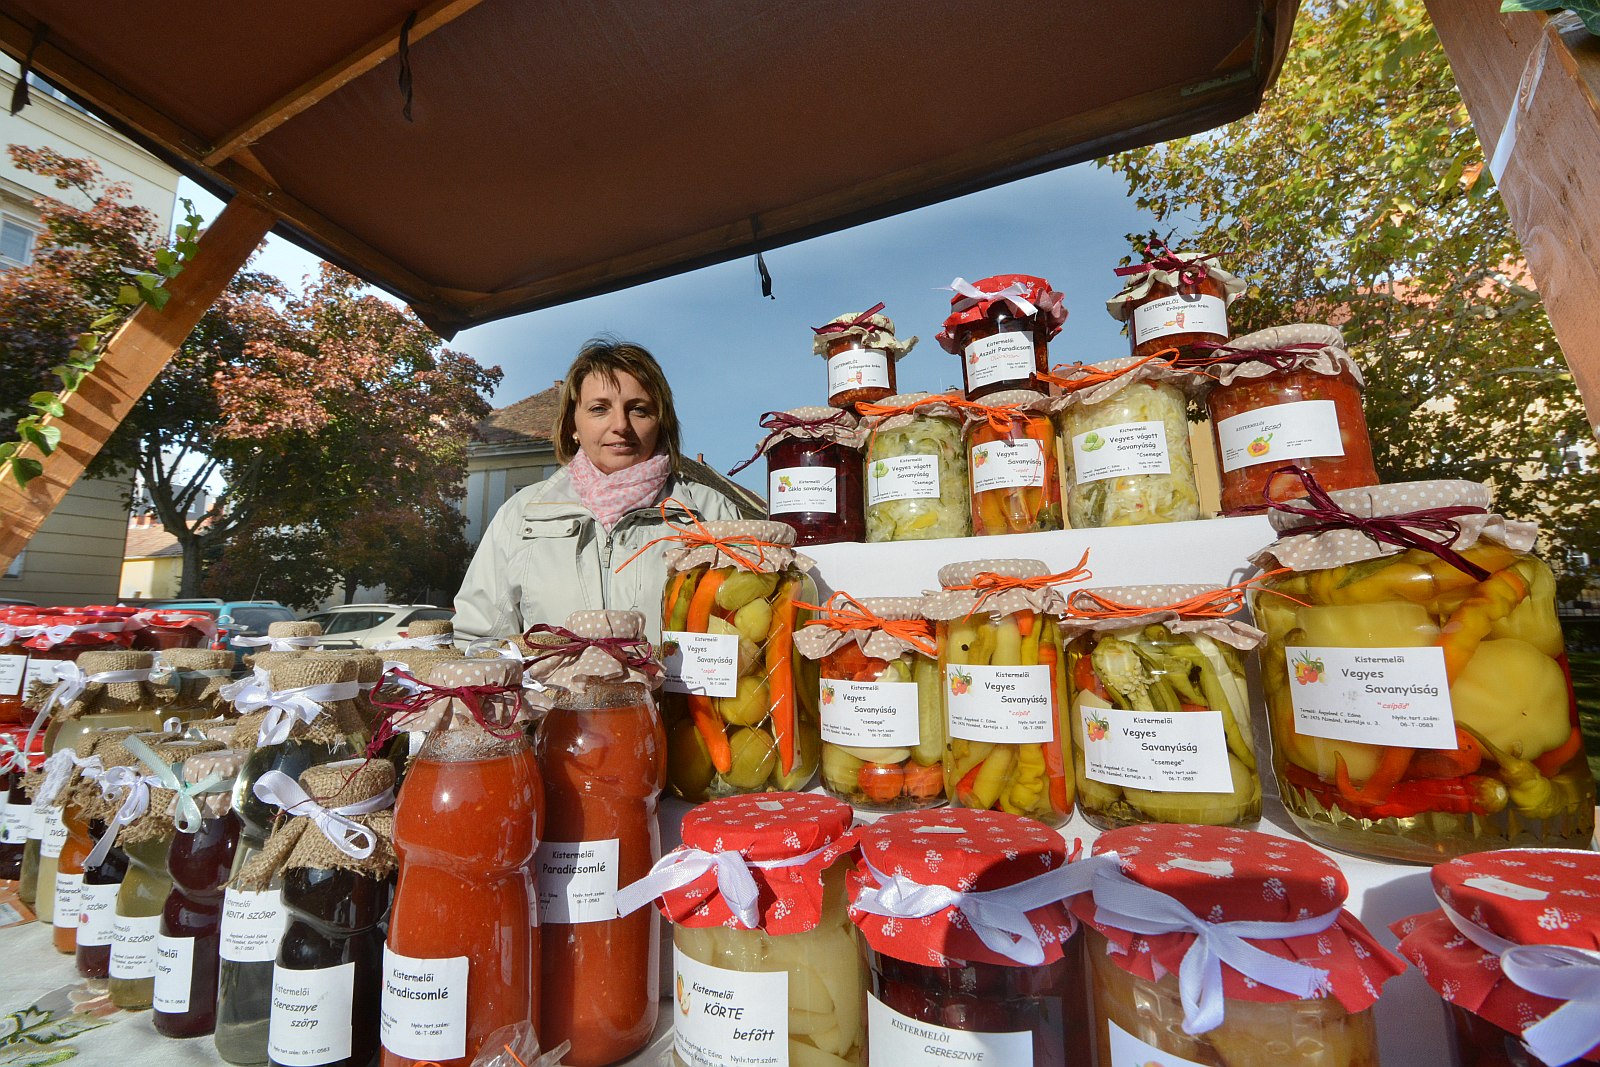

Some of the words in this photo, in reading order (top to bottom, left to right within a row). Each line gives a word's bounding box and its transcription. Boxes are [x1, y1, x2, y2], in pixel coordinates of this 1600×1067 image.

[1109, 435, 1135, 444] Vegyes
[1136, 433, 1158, 441] vágott
[1117, 442, 1156, 451] Savanyúság
[897, 471, 930, 479] Savanyúság
[687, 645, 707, 653] Vegyes
[697, 656, 733, 666] Savanyúság
[1341, 668, 1384, 680] Vegyes
[984, 682, 1016, 692] Vegyes
[1365, 684, 1439, 697] Savanyúság
[842, 694, 866, 703] Vegyes
[1001, 695, 1047, 705] Savanyúság
[854, 706, 897, 715] Savanyúság
[1123, 728, 1157, 739] Vegyes
[1141, 742, 1198, 754] Savanyúság
[1151, 758, 1185, 767] "csemege"
[542, 862, 606, 874] Paradicsomlé
[247, 911, 276, 920] SZÖRP
[127, 934, 155, 943] SZÖRP
[386, 980, 449, 1000] Paradicsomlé
[273, 997, 318, 1014] Cseresznye
[704, 1002, 744, 1020] KÖRTE
[291, 1018, 319, 1030] szörp
[708, 1049, 723, 1060] Edina
[924, 1045, 985, 1062] CSERESZNYE
